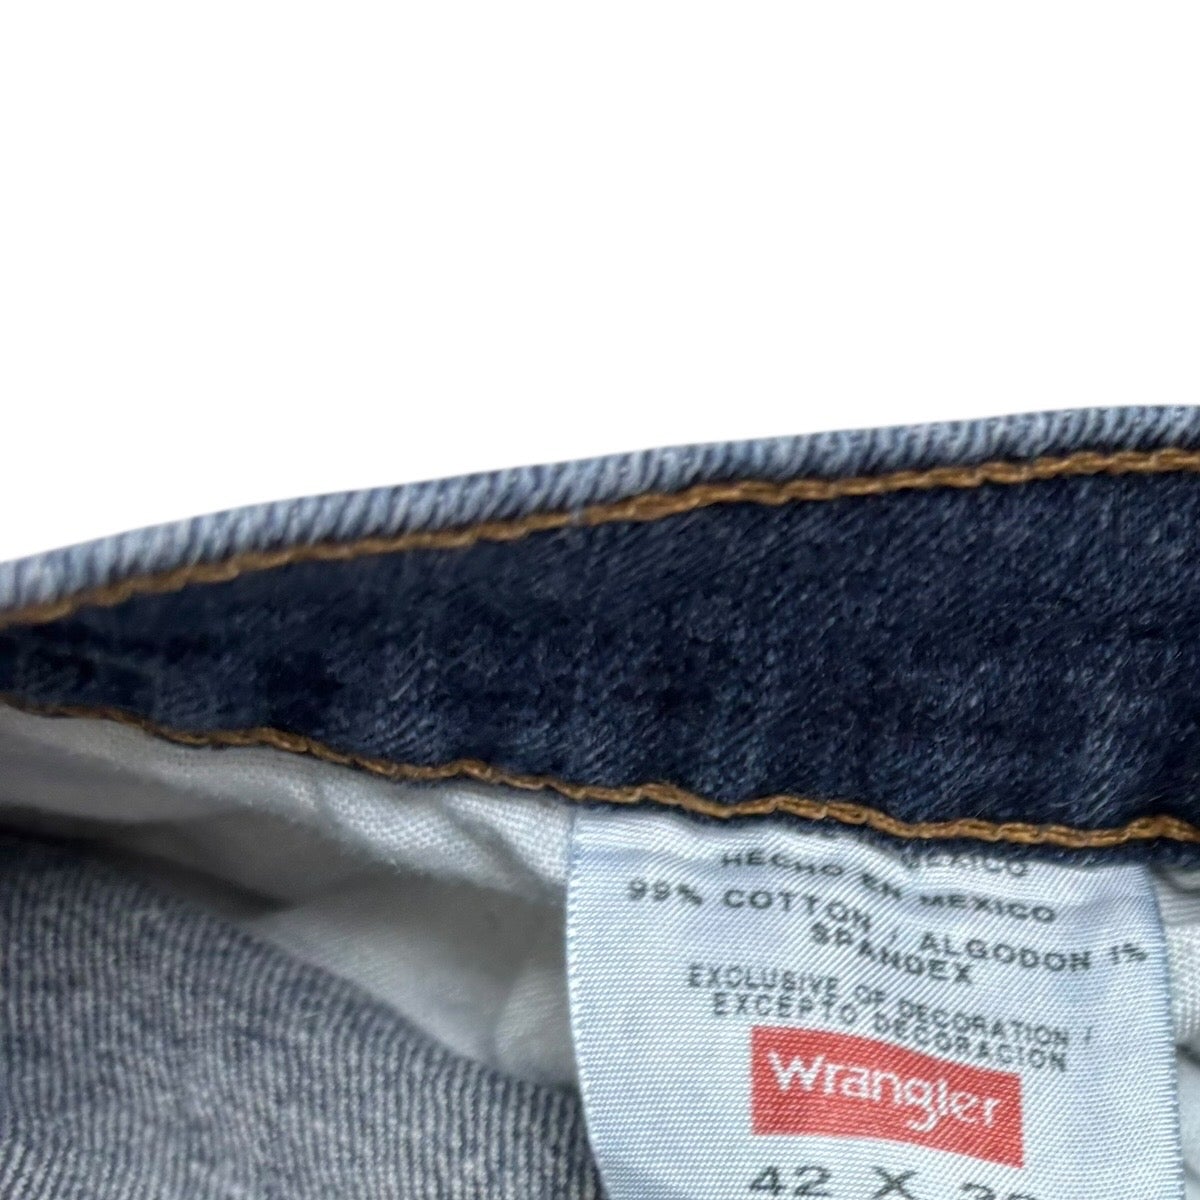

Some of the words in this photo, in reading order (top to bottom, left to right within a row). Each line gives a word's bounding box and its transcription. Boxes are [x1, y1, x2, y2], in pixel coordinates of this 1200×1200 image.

[628, 877, 703, 906] 99%
[723, 888, 871, 933] COTTON
[920, 931, 1090, 972] ALGODON
[722, 851, 844, 877] HECHO
[861, 872, 901, 898] EN
[919, 894, 1055, 922] MEXICO
[811, 921, 972, 985] SPANDEX
[688, 964, 838, 997] EXCLUSIVE
[855, 984, 886, 1004] OF
[900, 1000, 1068, 1047] DECORATION
[713, 991, 858, 1025] EXCEPTO
[873, 1011, 1067, 1071] DECORACION
[766, 1050, 1000, 1132] Wrangler
[750, 1165, 832, 1197] 42
[871, 1165, 917, 1200] X
